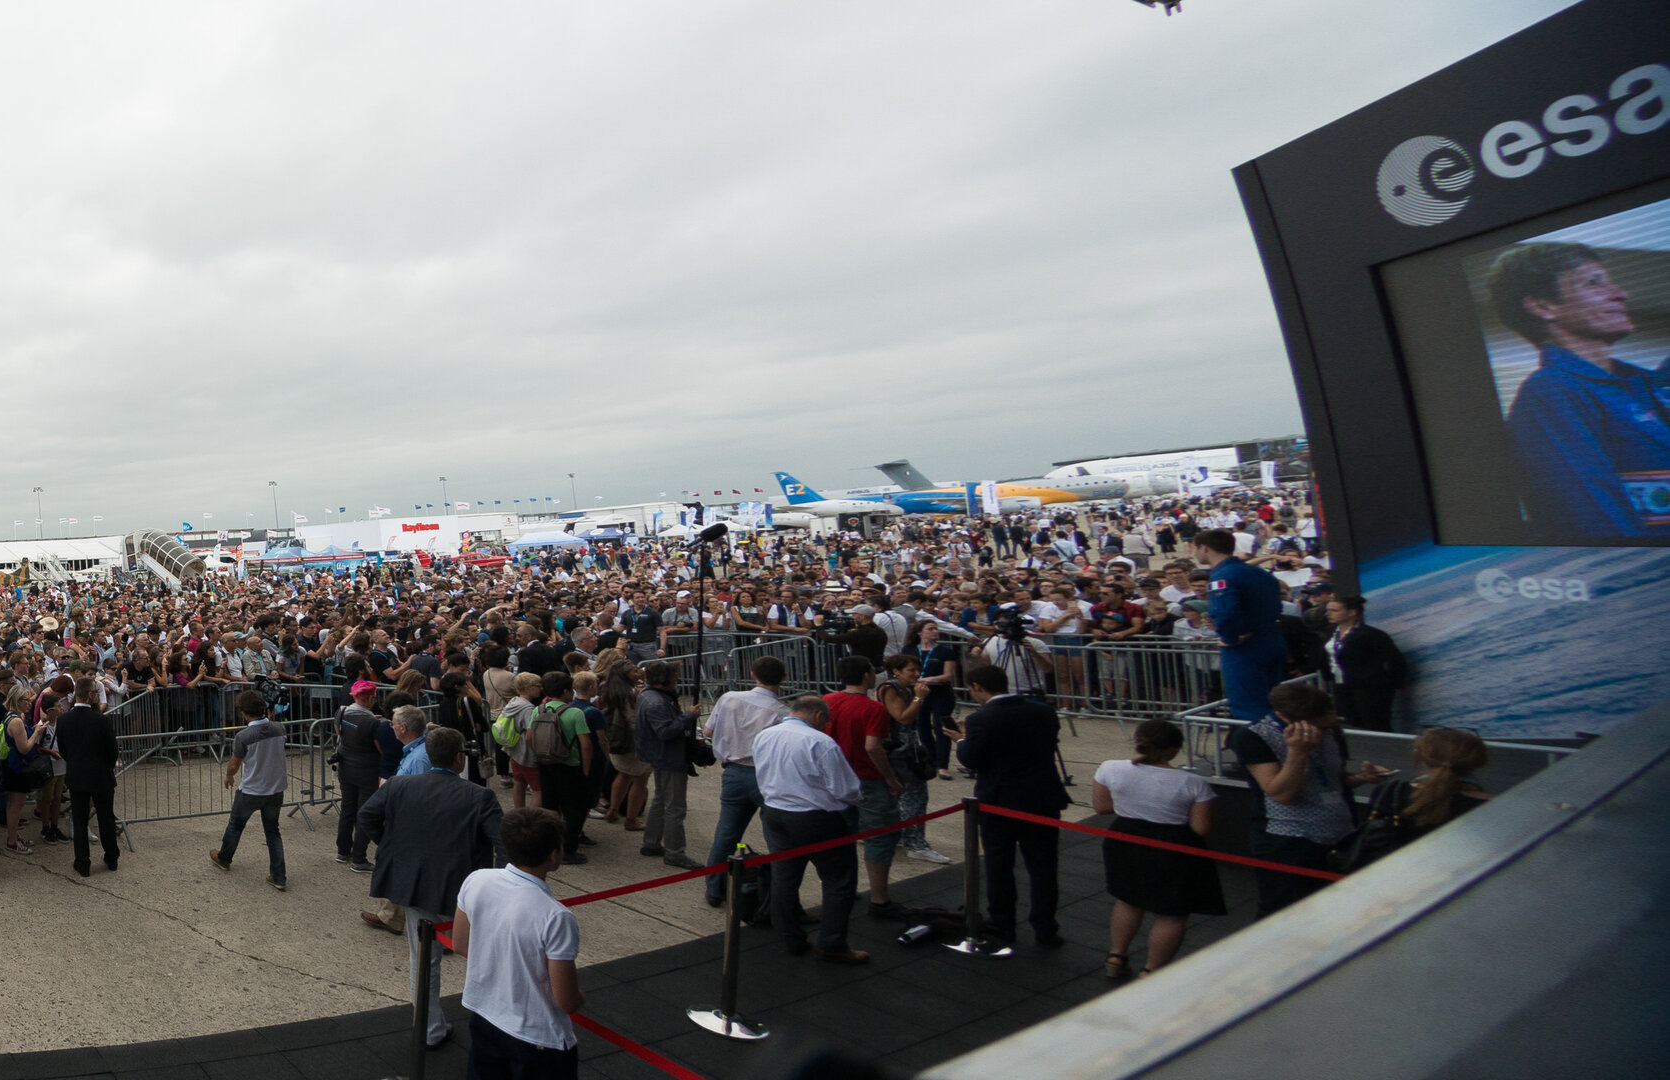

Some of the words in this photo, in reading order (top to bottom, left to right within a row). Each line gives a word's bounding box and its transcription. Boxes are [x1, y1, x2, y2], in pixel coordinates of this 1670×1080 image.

[1481, 64, 1670, 178] esa
[785, 484, 805, 496] E2
[402, 523, 439, 533] Raytheon
[1518, 577, 1589, 600] esa
